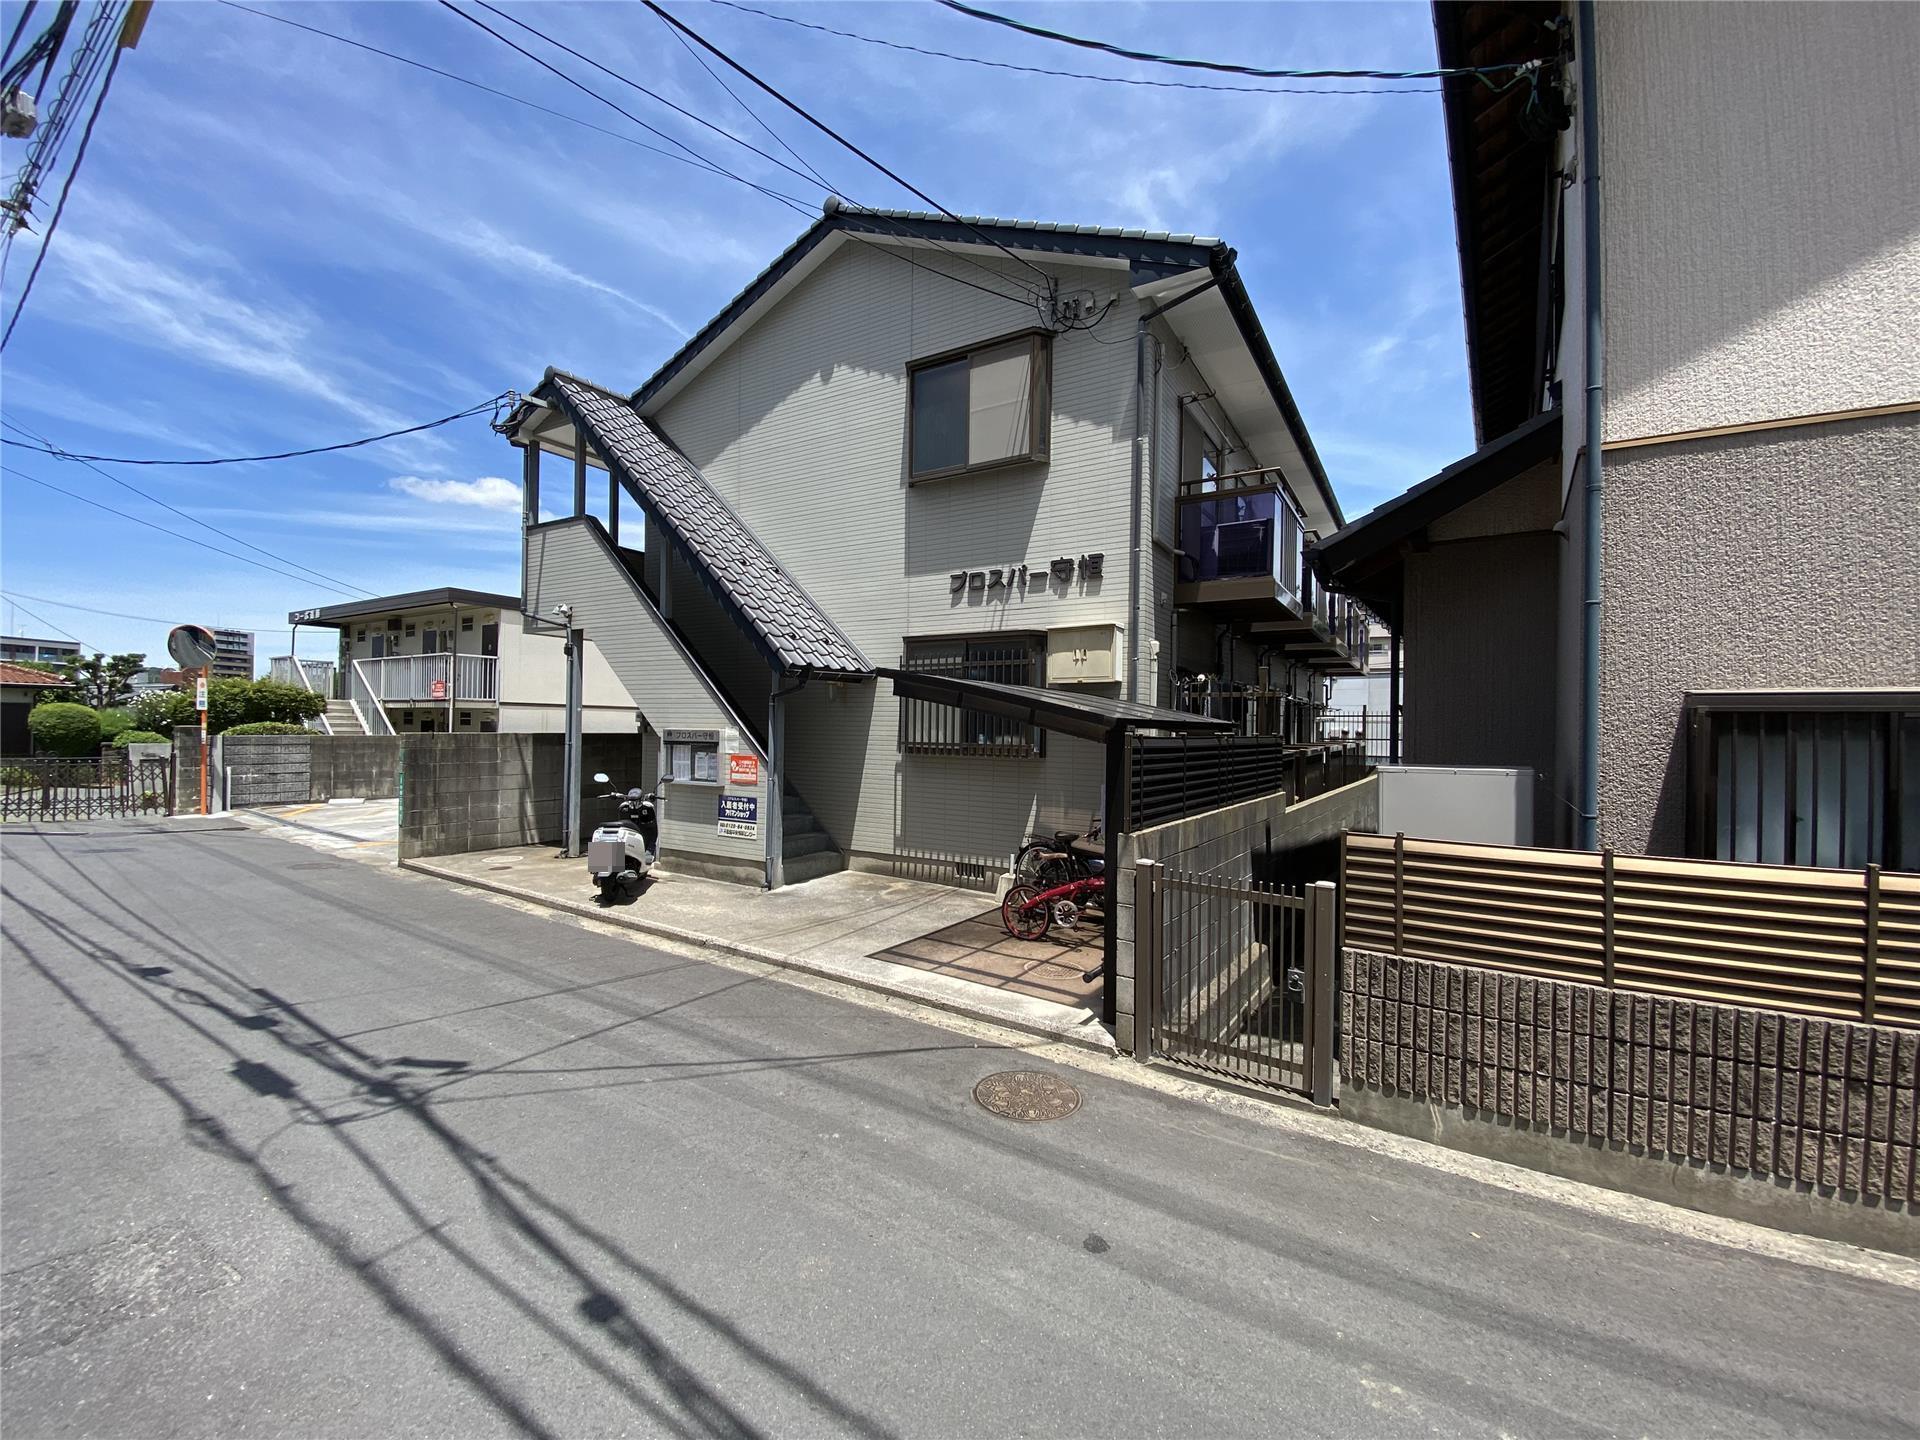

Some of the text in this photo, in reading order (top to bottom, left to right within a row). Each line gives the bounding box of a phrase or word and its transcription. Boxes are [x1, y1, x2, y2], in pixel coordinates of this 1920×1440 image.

[950, 553, 1105, 592] プロスパー守恒
